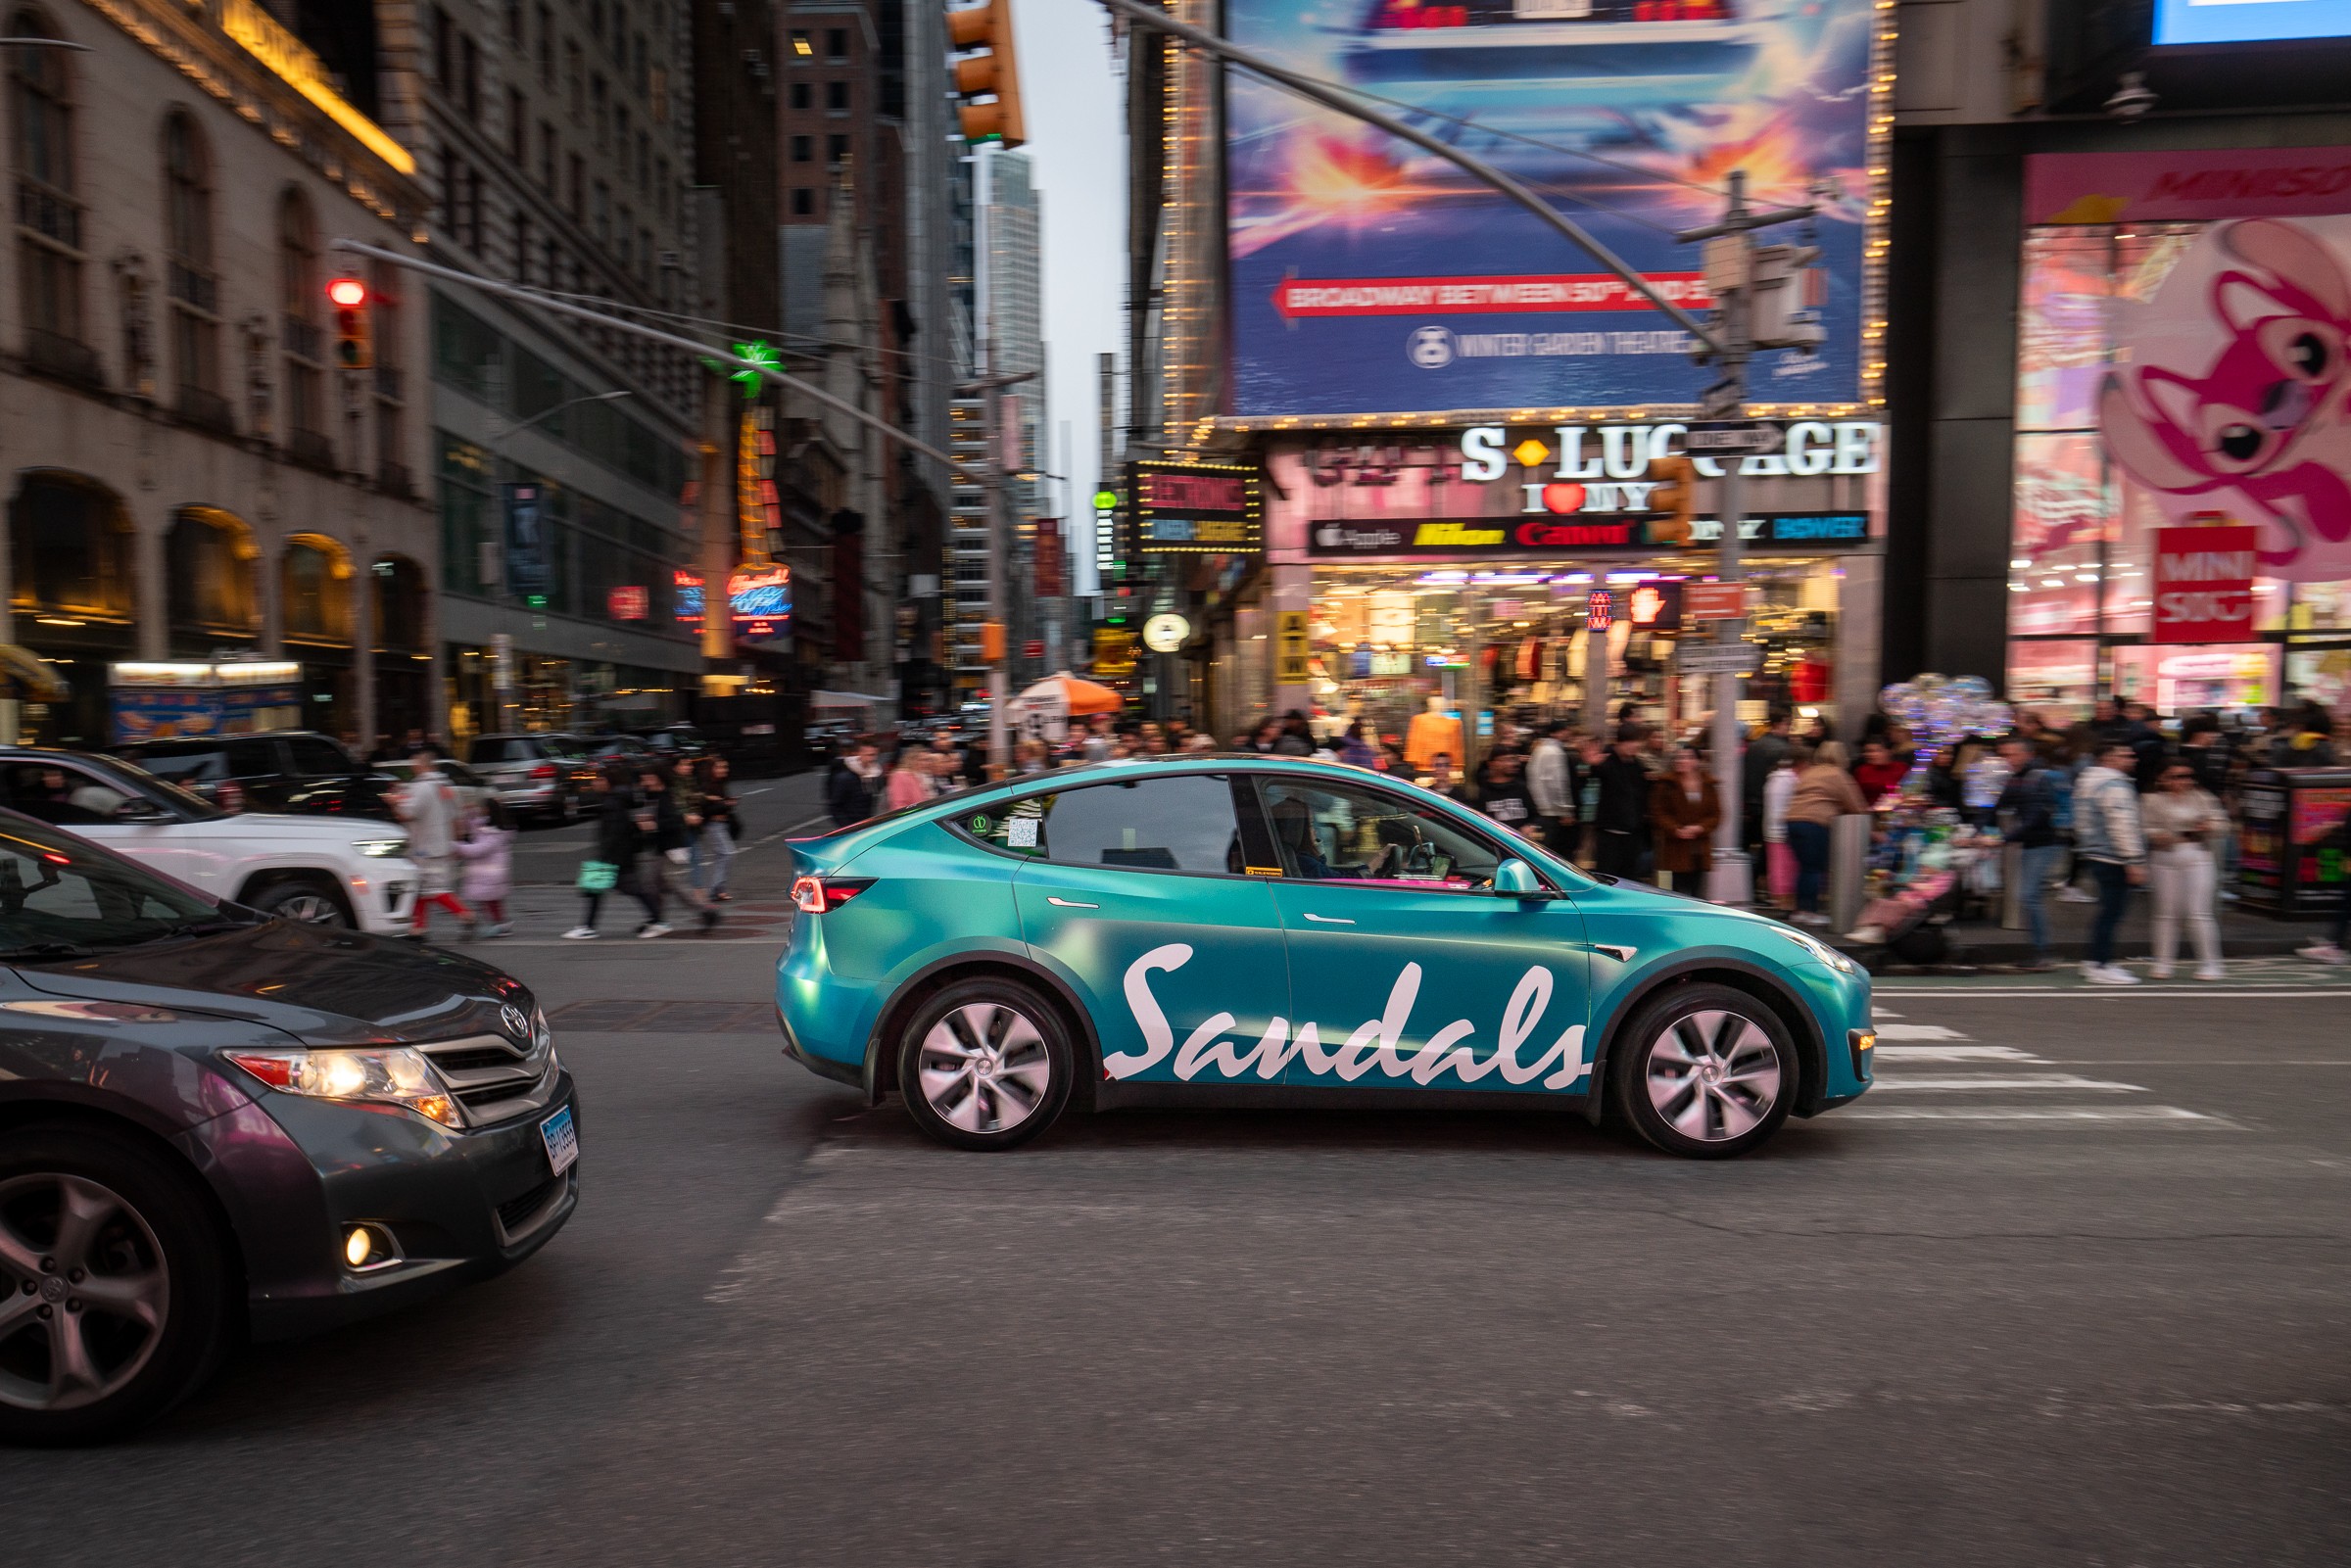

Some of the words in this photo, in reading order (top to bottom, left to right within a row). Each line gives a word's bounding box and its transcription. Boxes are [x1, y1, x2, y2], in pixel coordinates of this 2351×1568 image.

[1286, 277, 1433, 309] BROADWAY
[1436, 281, 1569, 307] BETWEEN
[1458, 333, 1526, 357] WINTER
[1530, 332, 1605, 356] GARDEN
[1343, 527, 1402, 549] Apple
[1412, 522, 1507, 546] Nikon
[1515, 521, 1630, 546] Canon
[1104, 942, 1594, 1089] Sandals
